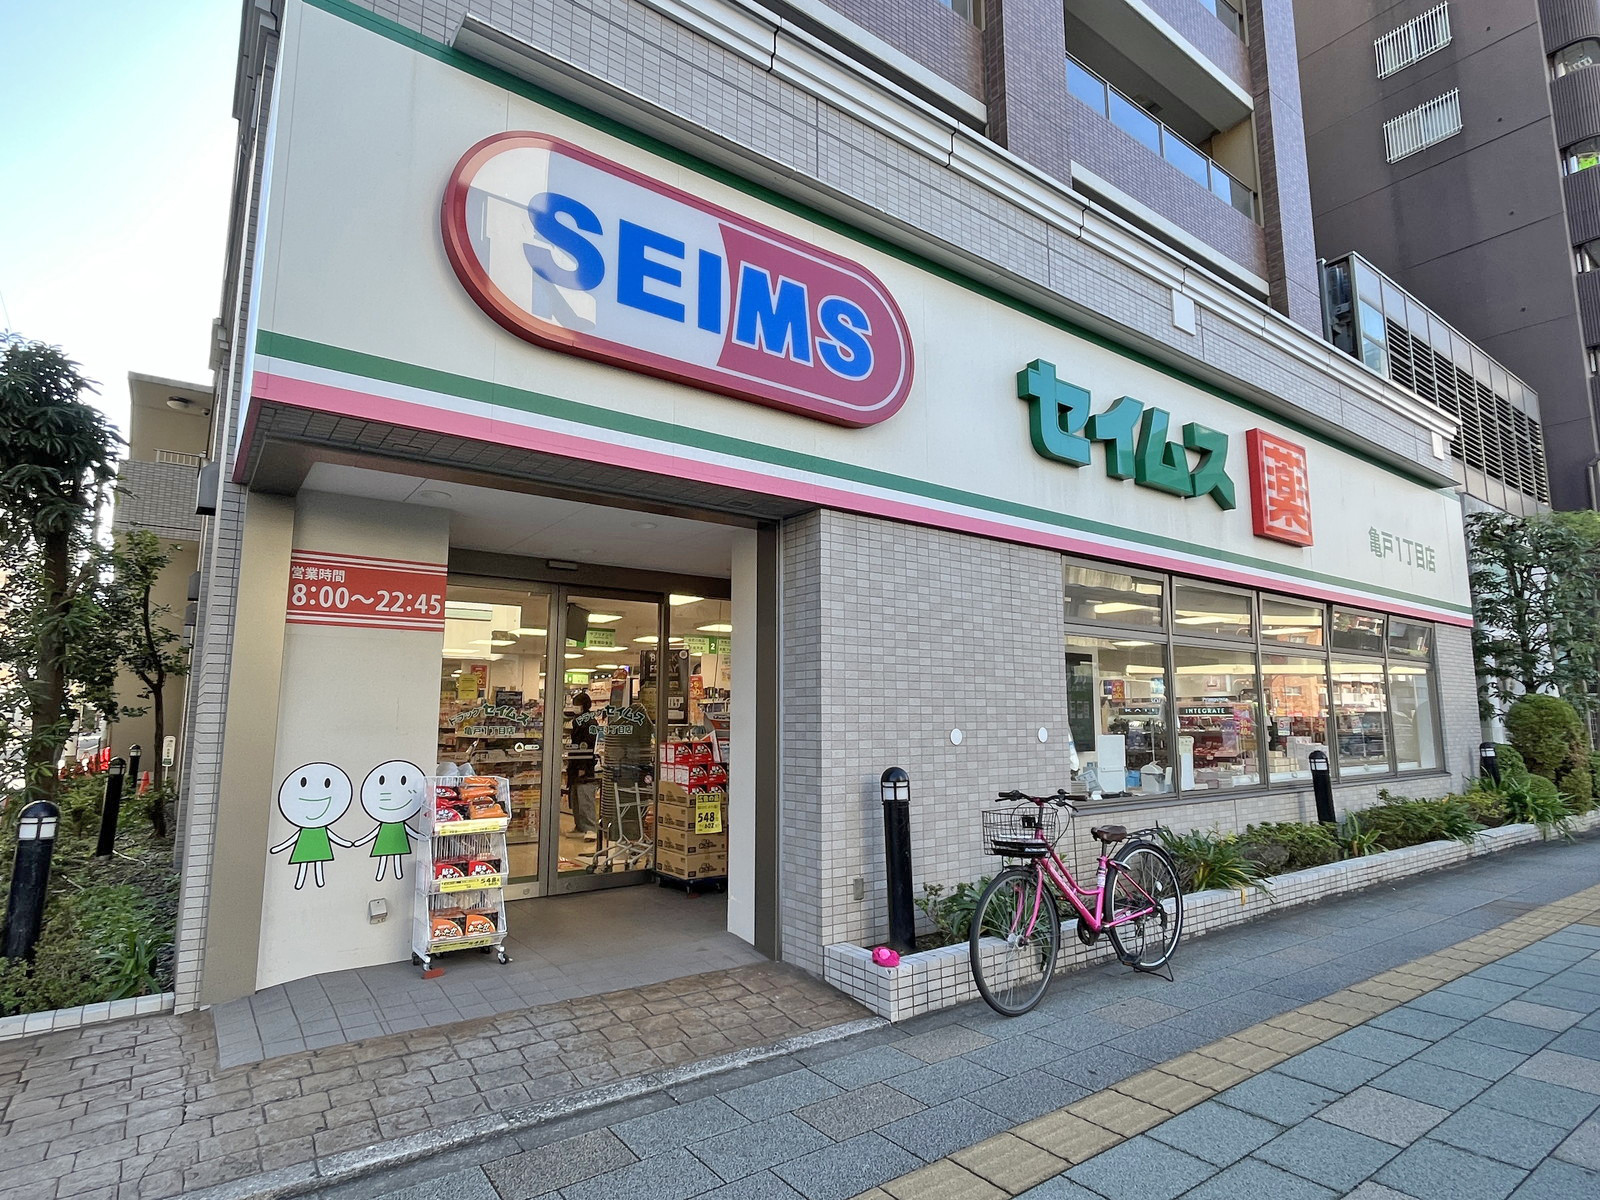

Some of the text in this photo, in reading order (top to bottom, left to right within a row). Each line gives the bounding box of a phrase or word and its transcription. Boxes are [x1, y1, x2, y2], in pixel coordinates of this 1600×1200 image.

[523, 192, 875, 381] SEIMS
[1017, 358, 1236, 511] セイムス
[1264, 443, 1309, 531] 薬
[291, 566, 345, 583] 営業時間
[1368, 526, 1436, 573] 亀戸1丁目店
[697, 812, 715, 823] 548
